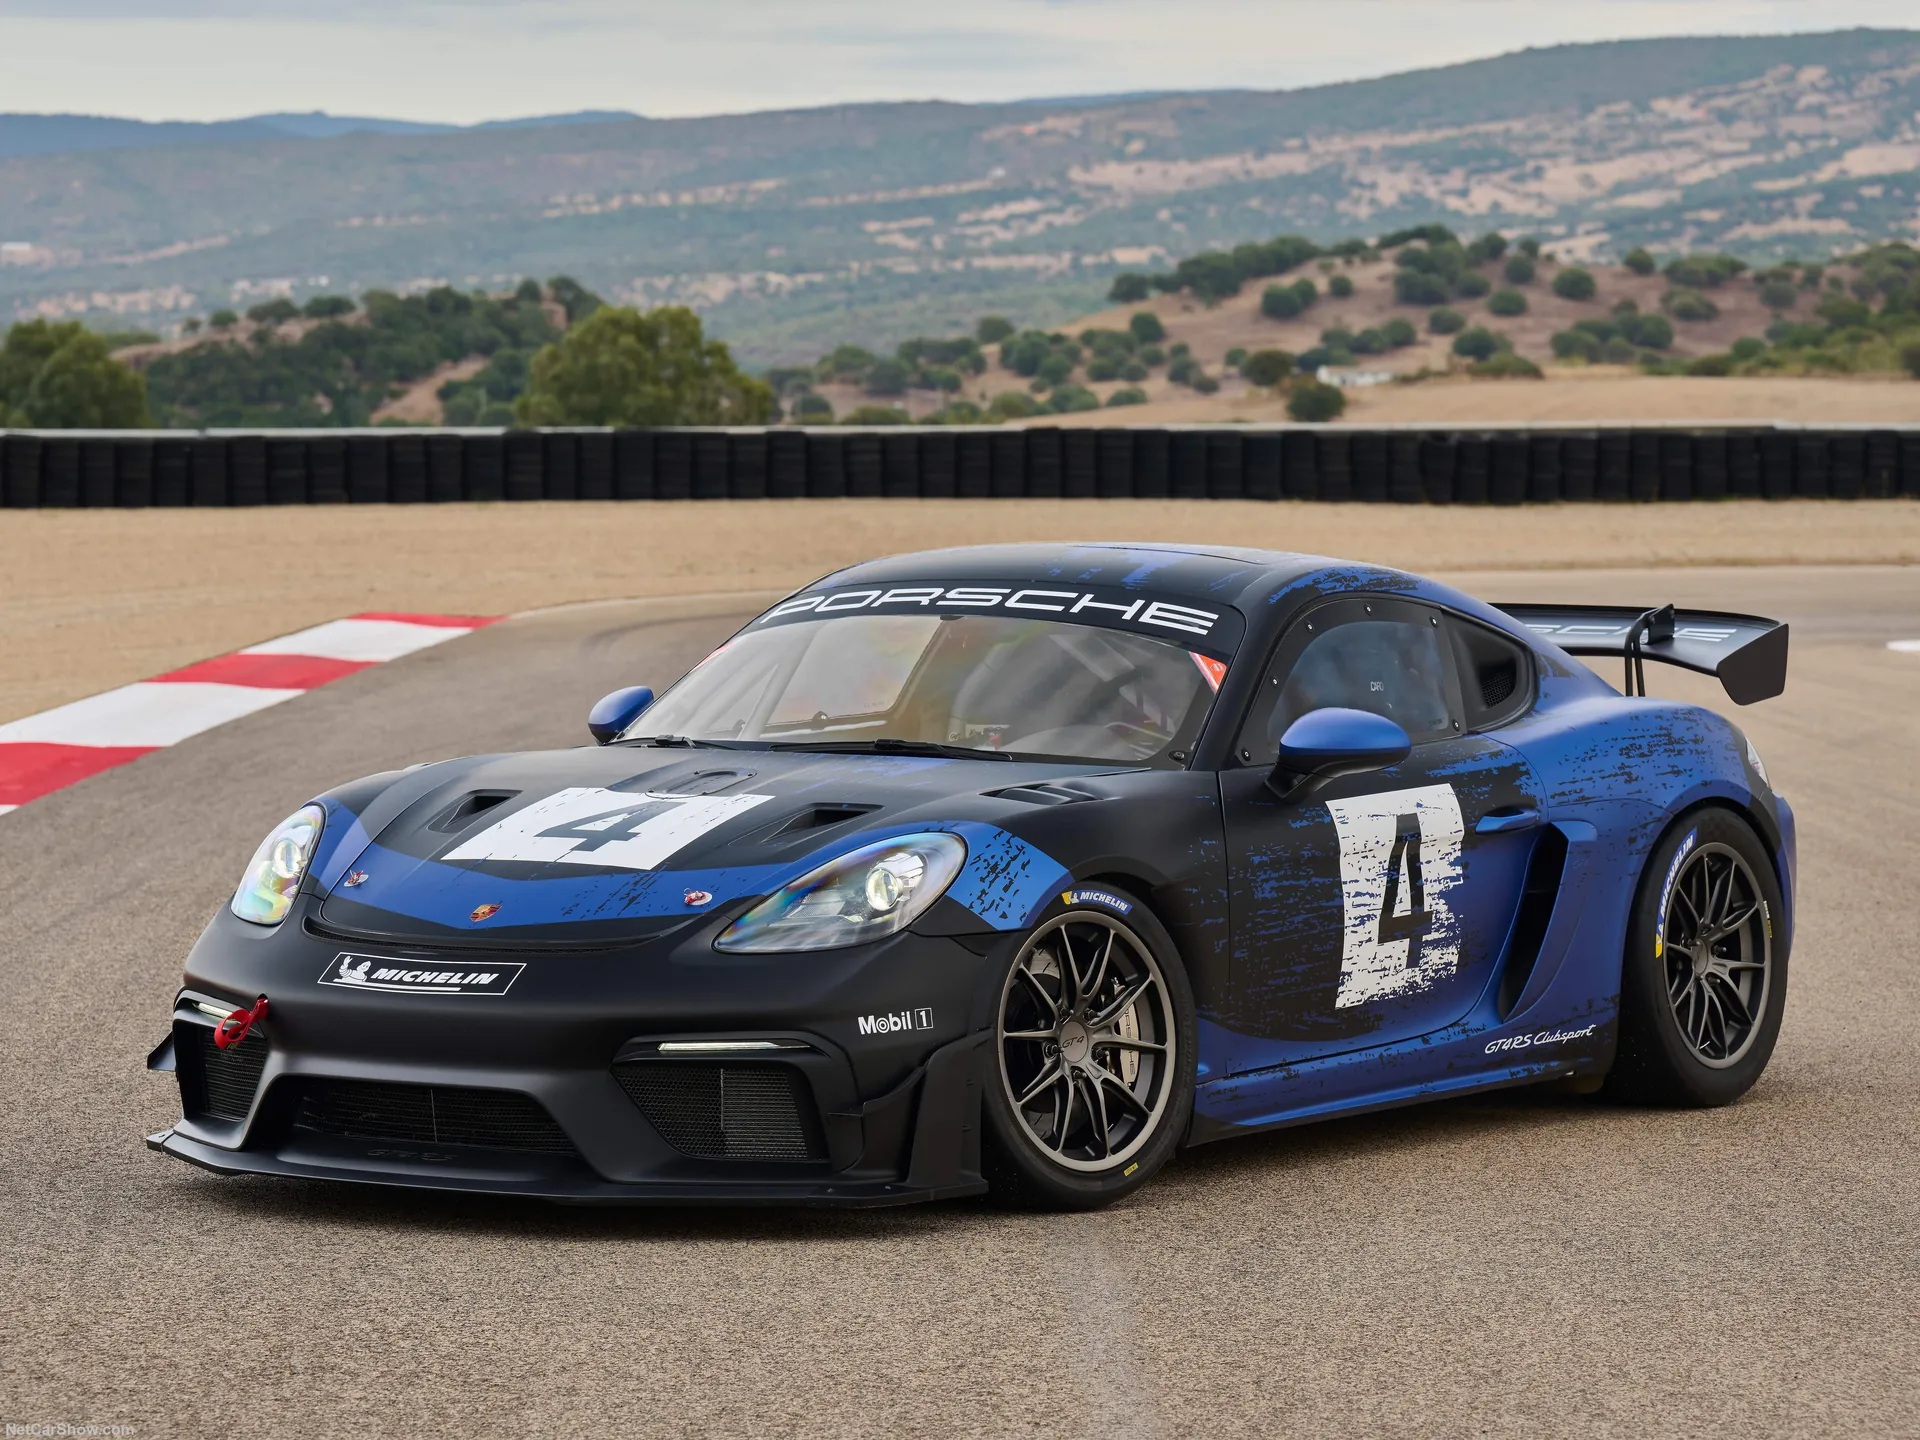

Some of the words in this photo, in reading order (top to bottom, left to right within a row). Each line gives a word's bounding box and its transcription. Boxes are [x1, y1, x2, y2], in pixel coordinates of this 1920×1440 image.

[761, 587, 1219, 635] PORSCHE
[533, 800, 688, 852] 4
[1377, 813, 1434, 970] 4
[1660, 834, 1694, 919] MICHELIN
[1080, 891, 1128, 911] MICHELIN
[370, 967, 499, 985] MICHELIN
[857, 1010, 912, 1035] Mobil
[1533, 1024, 1597, 1045] Clubsport
